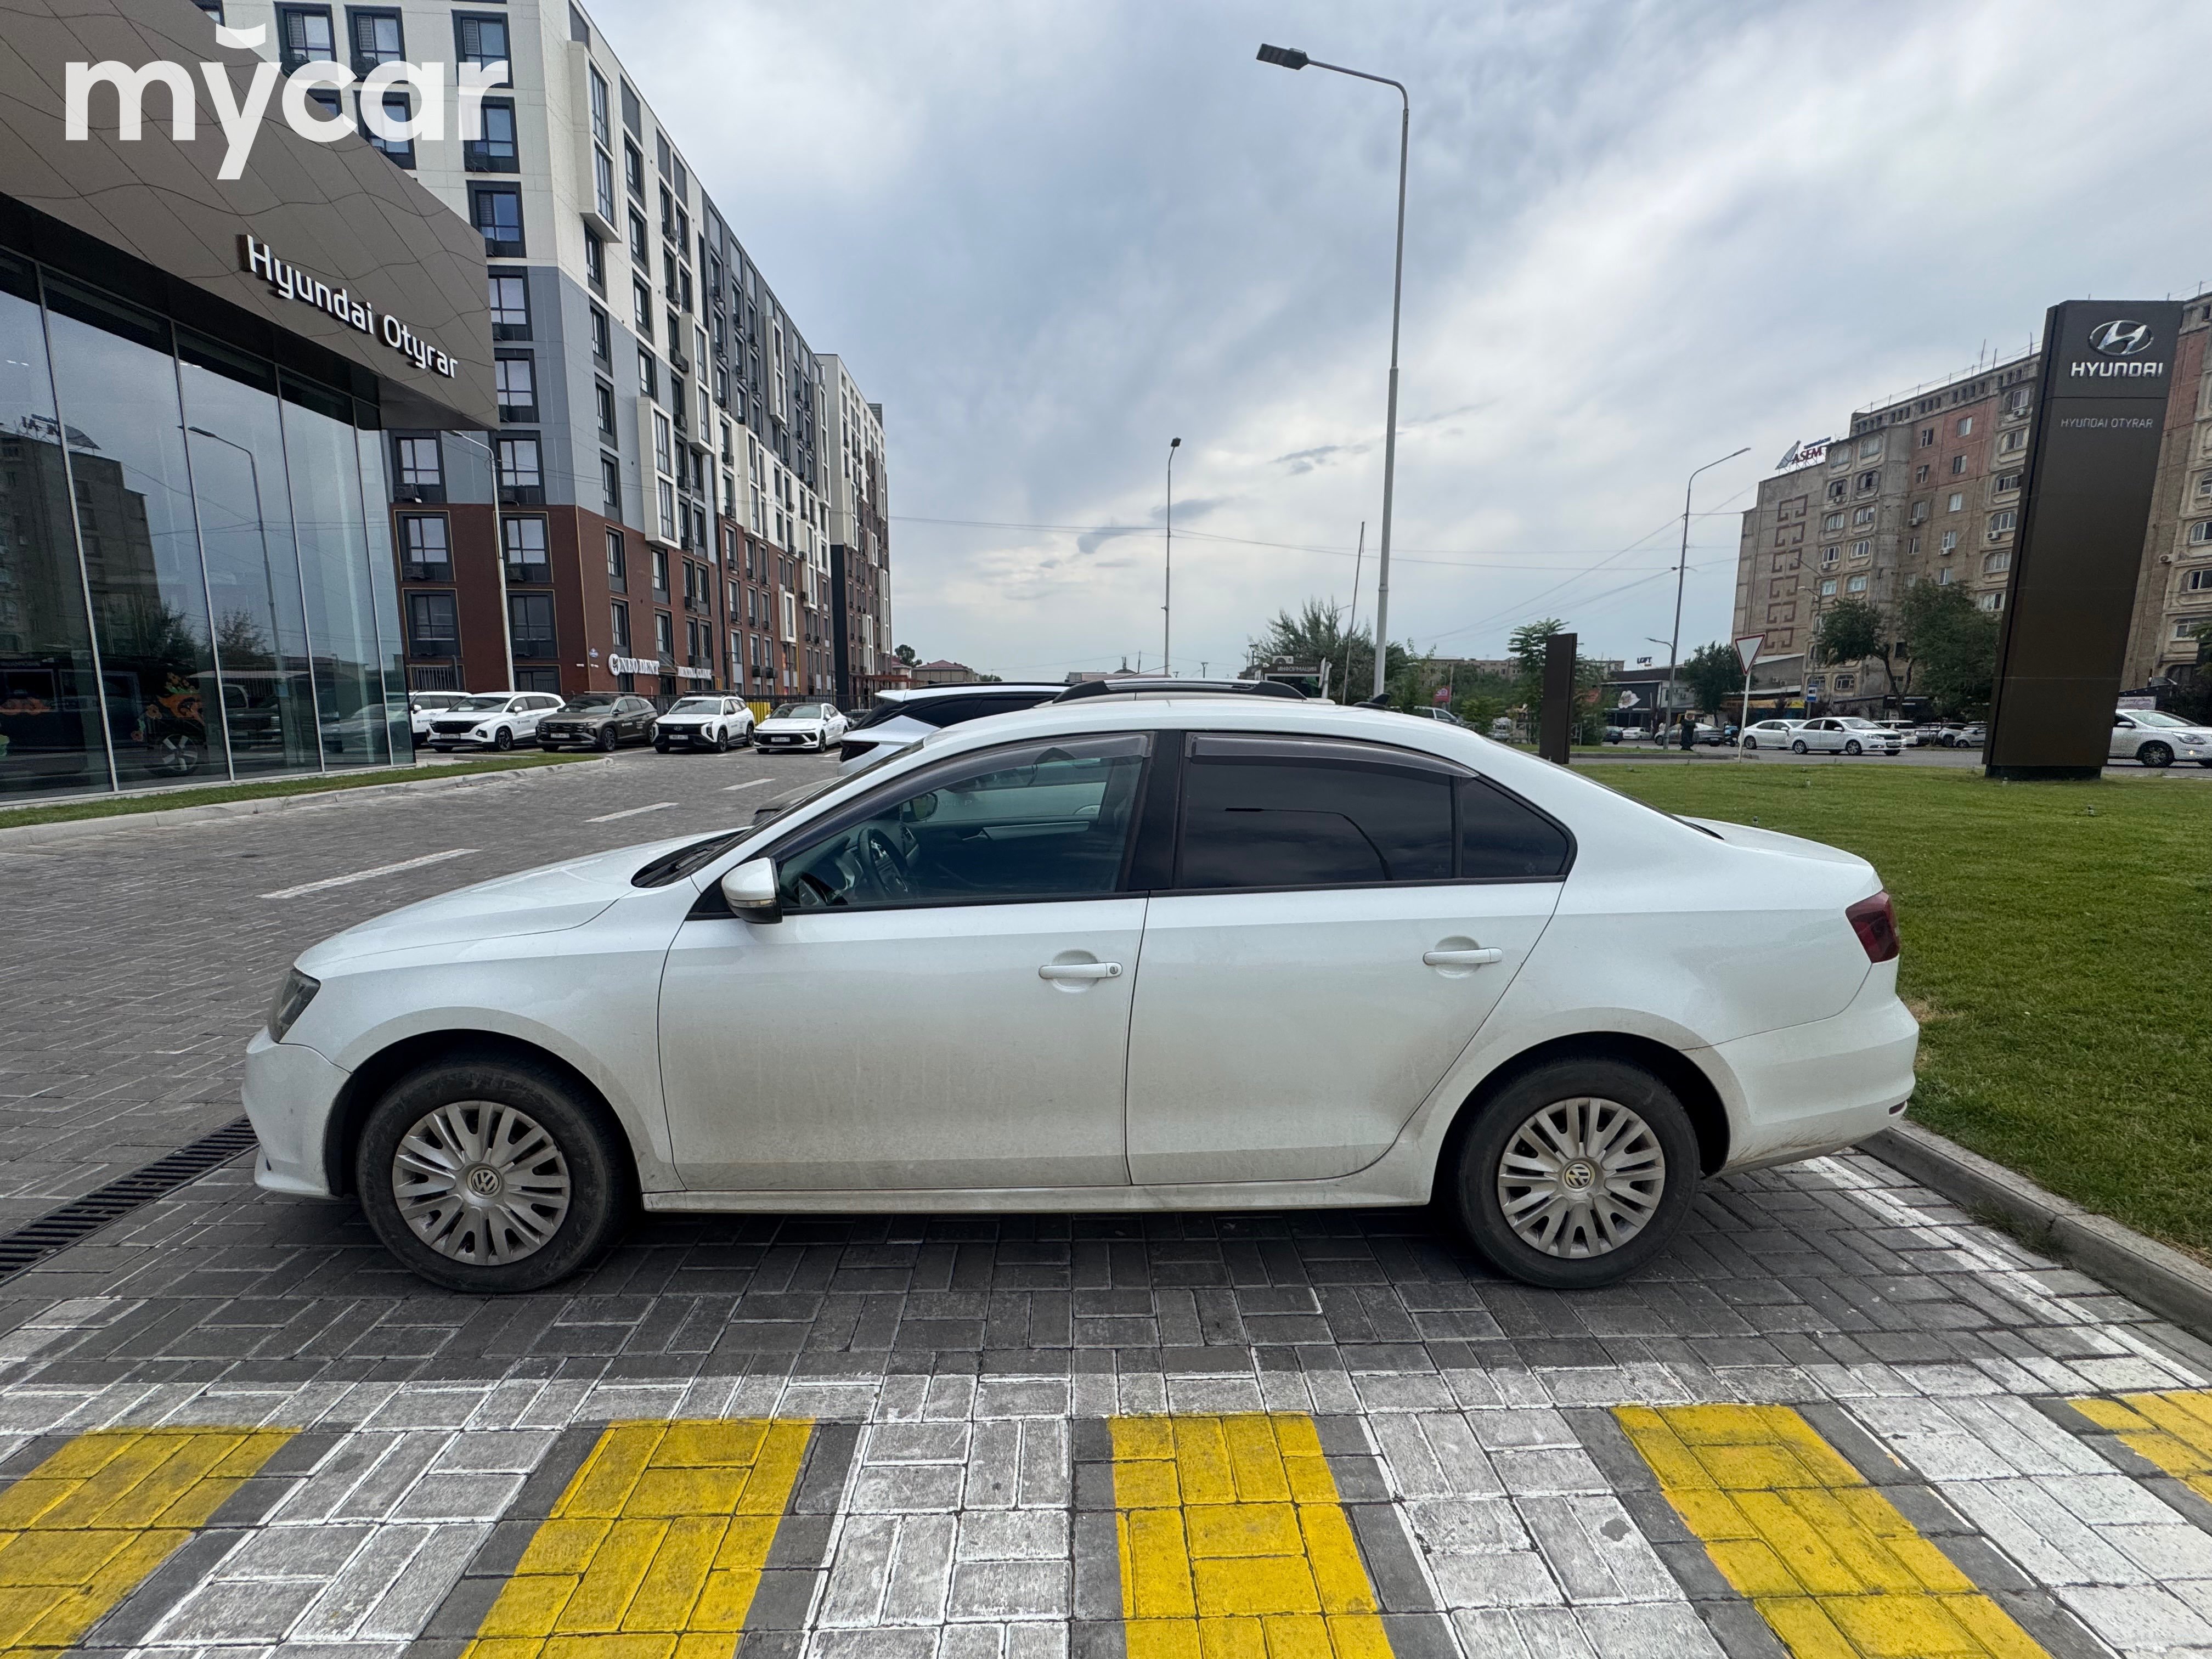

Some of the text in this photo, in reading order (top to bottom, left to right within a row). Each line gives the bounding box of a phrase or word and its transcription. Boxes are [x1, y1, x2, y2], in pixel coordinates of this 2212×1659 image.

[247, 234, 459, 379] Hyundai Otyrar
[2070, 362, 2164, 377] HYUNDAI
[2061, 417, 2154, 428] HYUNDAI OTYRAR
[1791, 447, 1822, 465] ASEM
[620, 658, 660, 675] NEO DENT
